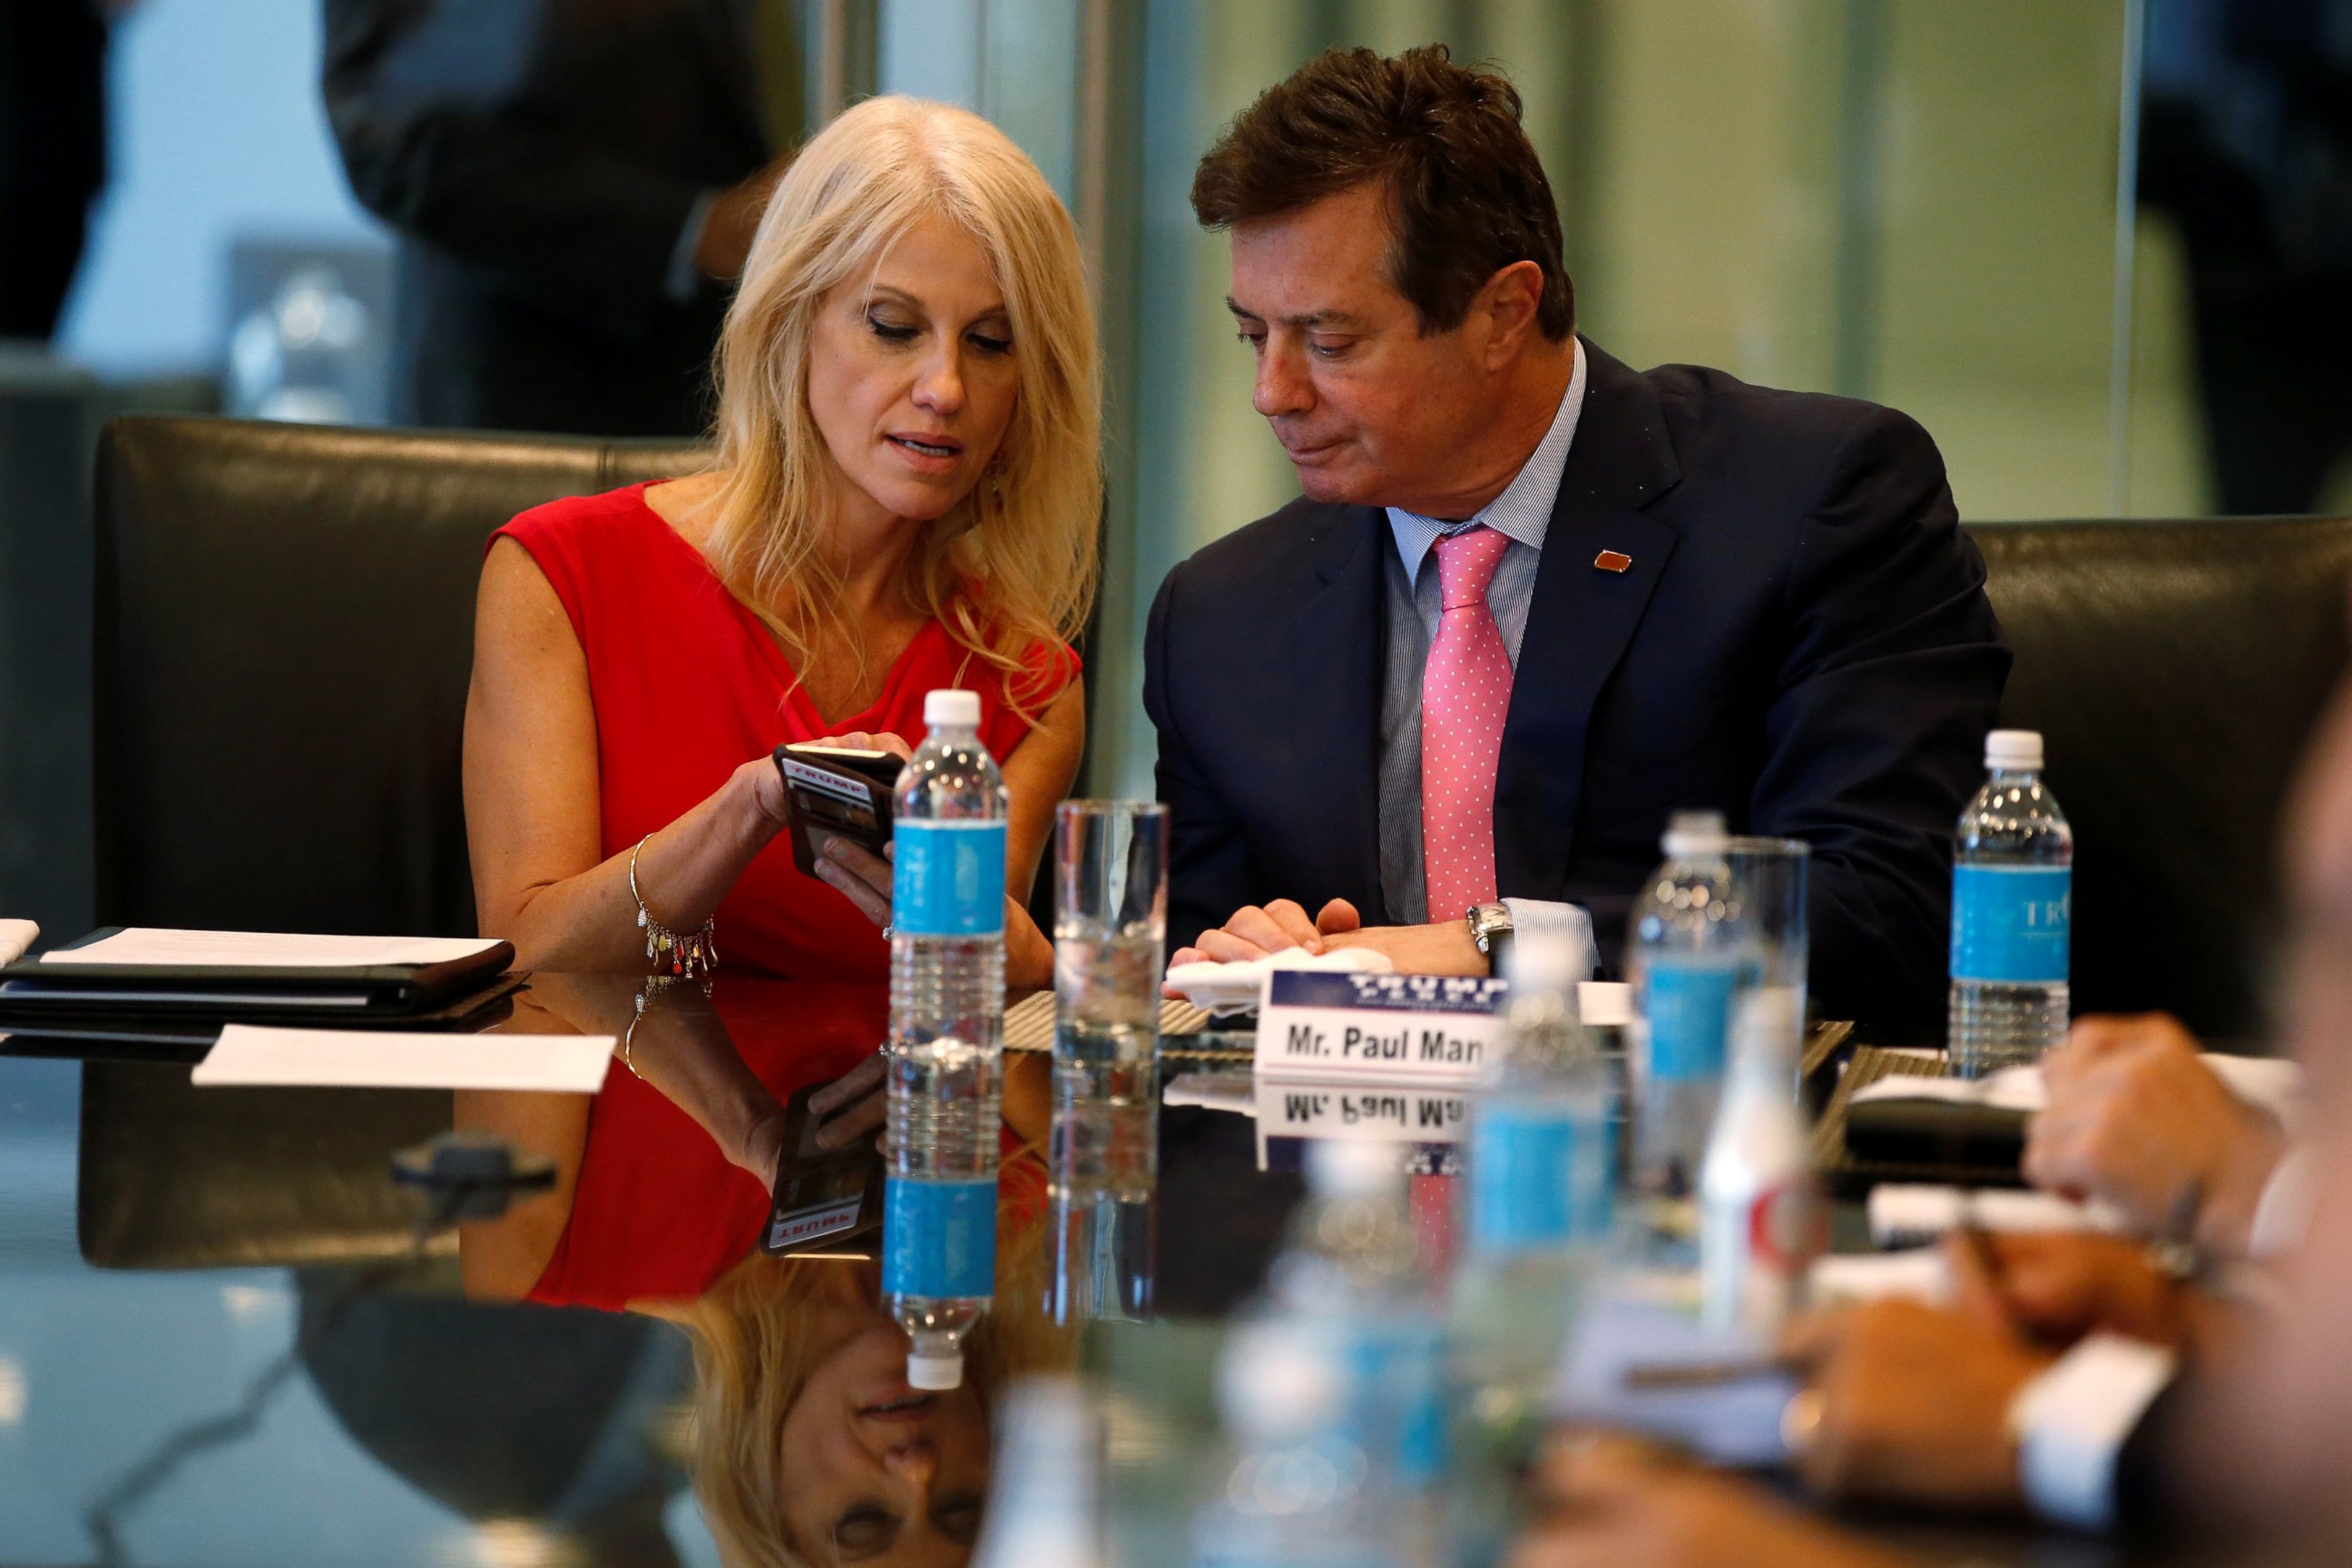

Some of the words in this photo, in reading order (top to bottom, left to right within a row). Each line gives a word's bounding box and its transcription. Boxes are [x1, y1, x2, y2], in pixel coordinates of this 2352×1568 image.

[792, 766, 861, 792] TRUMP
[1349, 975, 1508, 995] TRUMP
[1287, 1025, 1330, 1056] Mr.
[1343, 1027, 1408, 1059] Paul
[1420, 1031, 1485, 1063] Man
